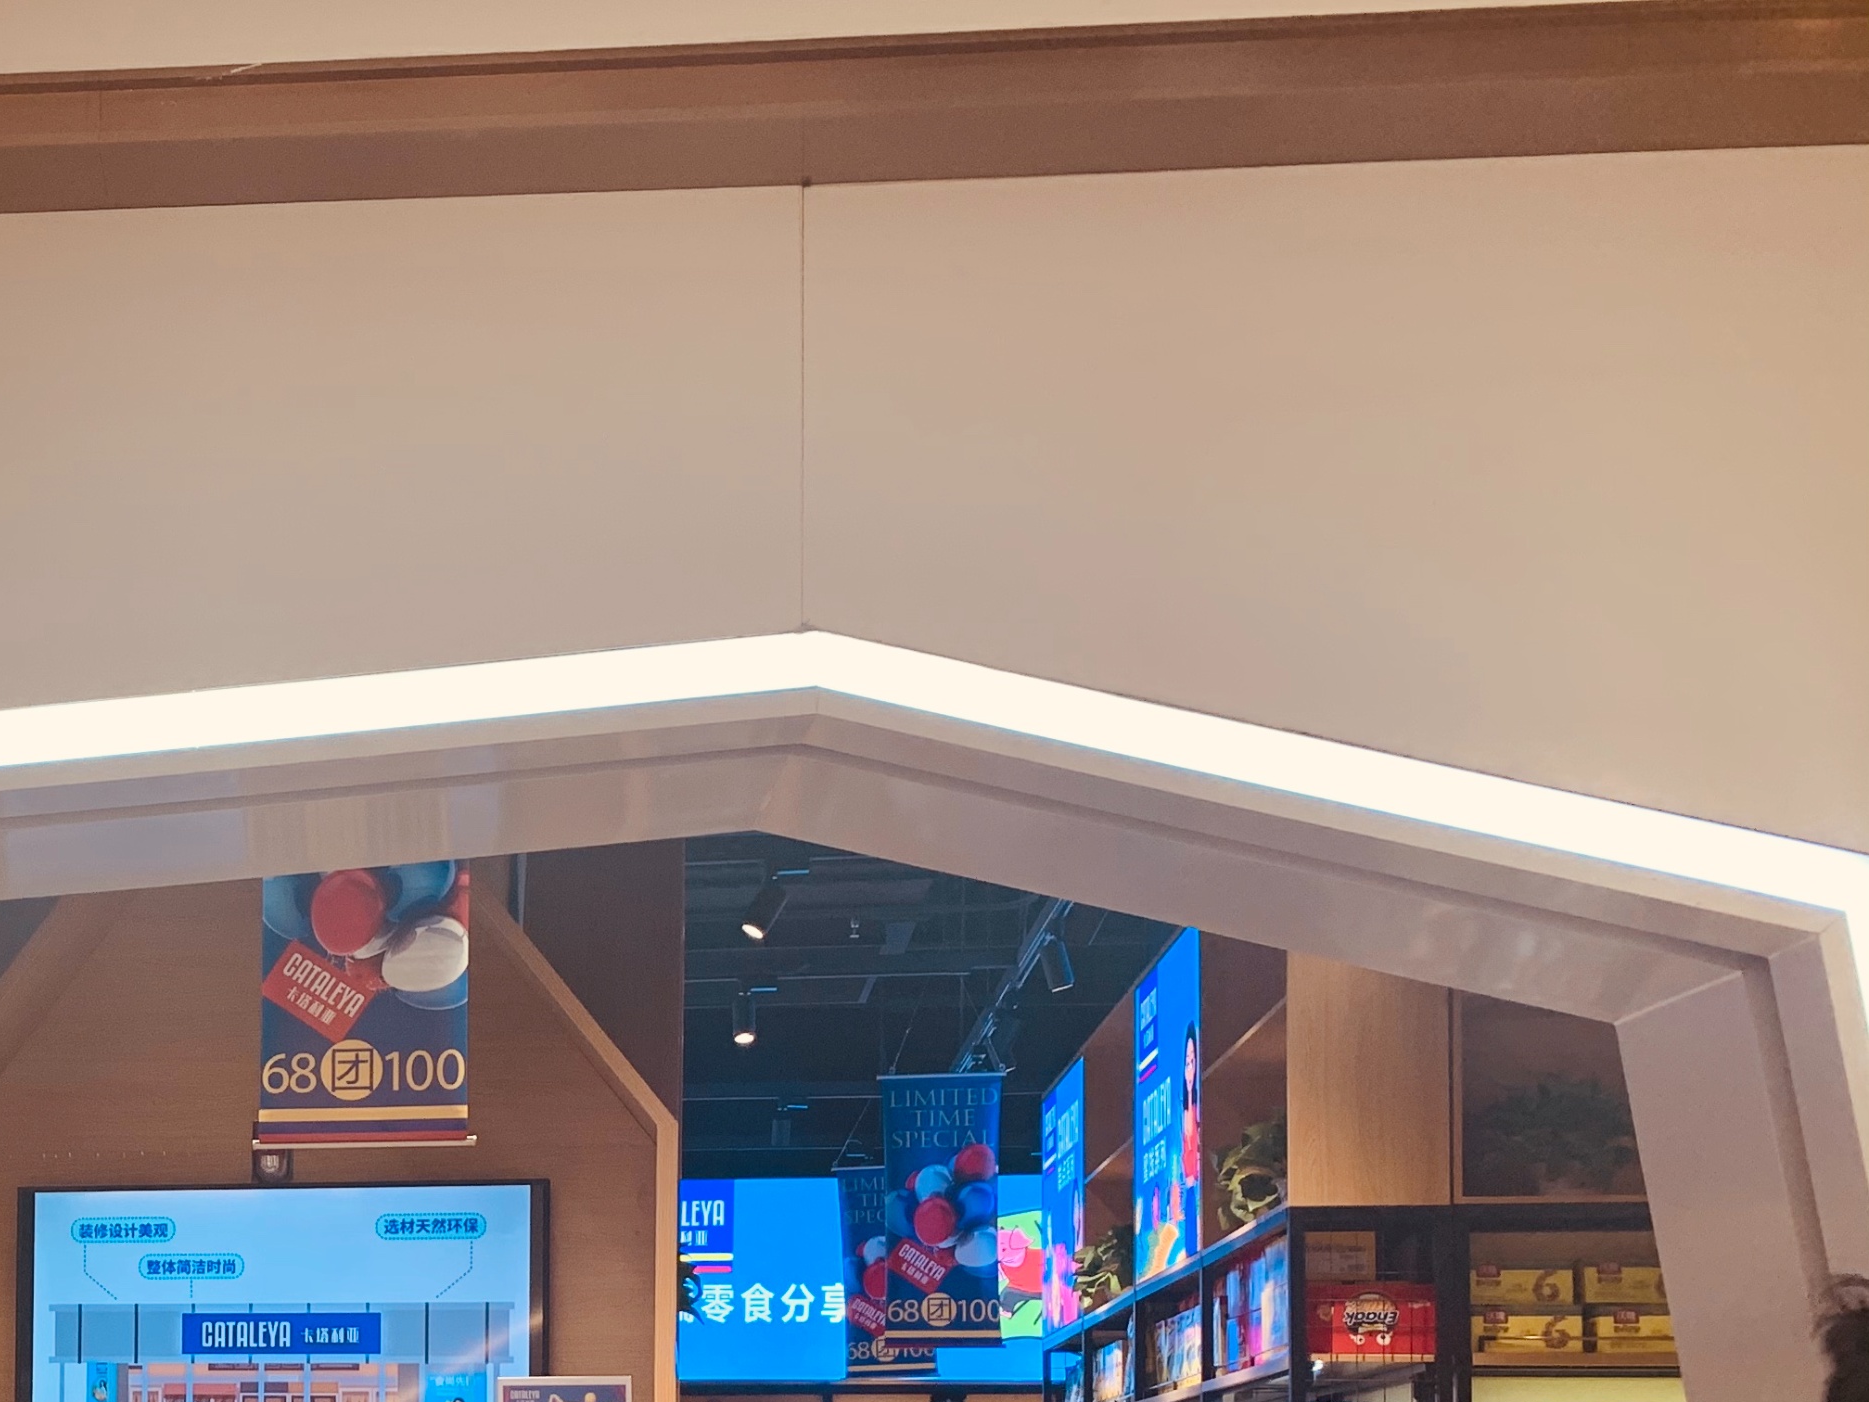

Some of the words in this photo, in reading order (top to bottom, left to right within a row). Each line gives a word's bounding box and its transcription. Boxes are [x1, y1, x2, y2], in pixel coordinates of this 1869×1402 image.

[283, 953, 366, 1018] CATALEYA
[890, 1087, 998, 1108] LIMITED
[910, 1109, 975, 1127] TIME
[892, 1130, 995, 1148] SPECIAL
[78, 1222, 170, 1240] 装修设计美观
[383, 1216, 480, 1235] 选材天然环保
[146, 1258, 237, 1275] 整体简洁时尚
[898, 1243, 946, 1281] CATALEYA
[1344, 1310, 1399, 1326] Enaak
[201, 1321, 291, 1348] CATALEYA
